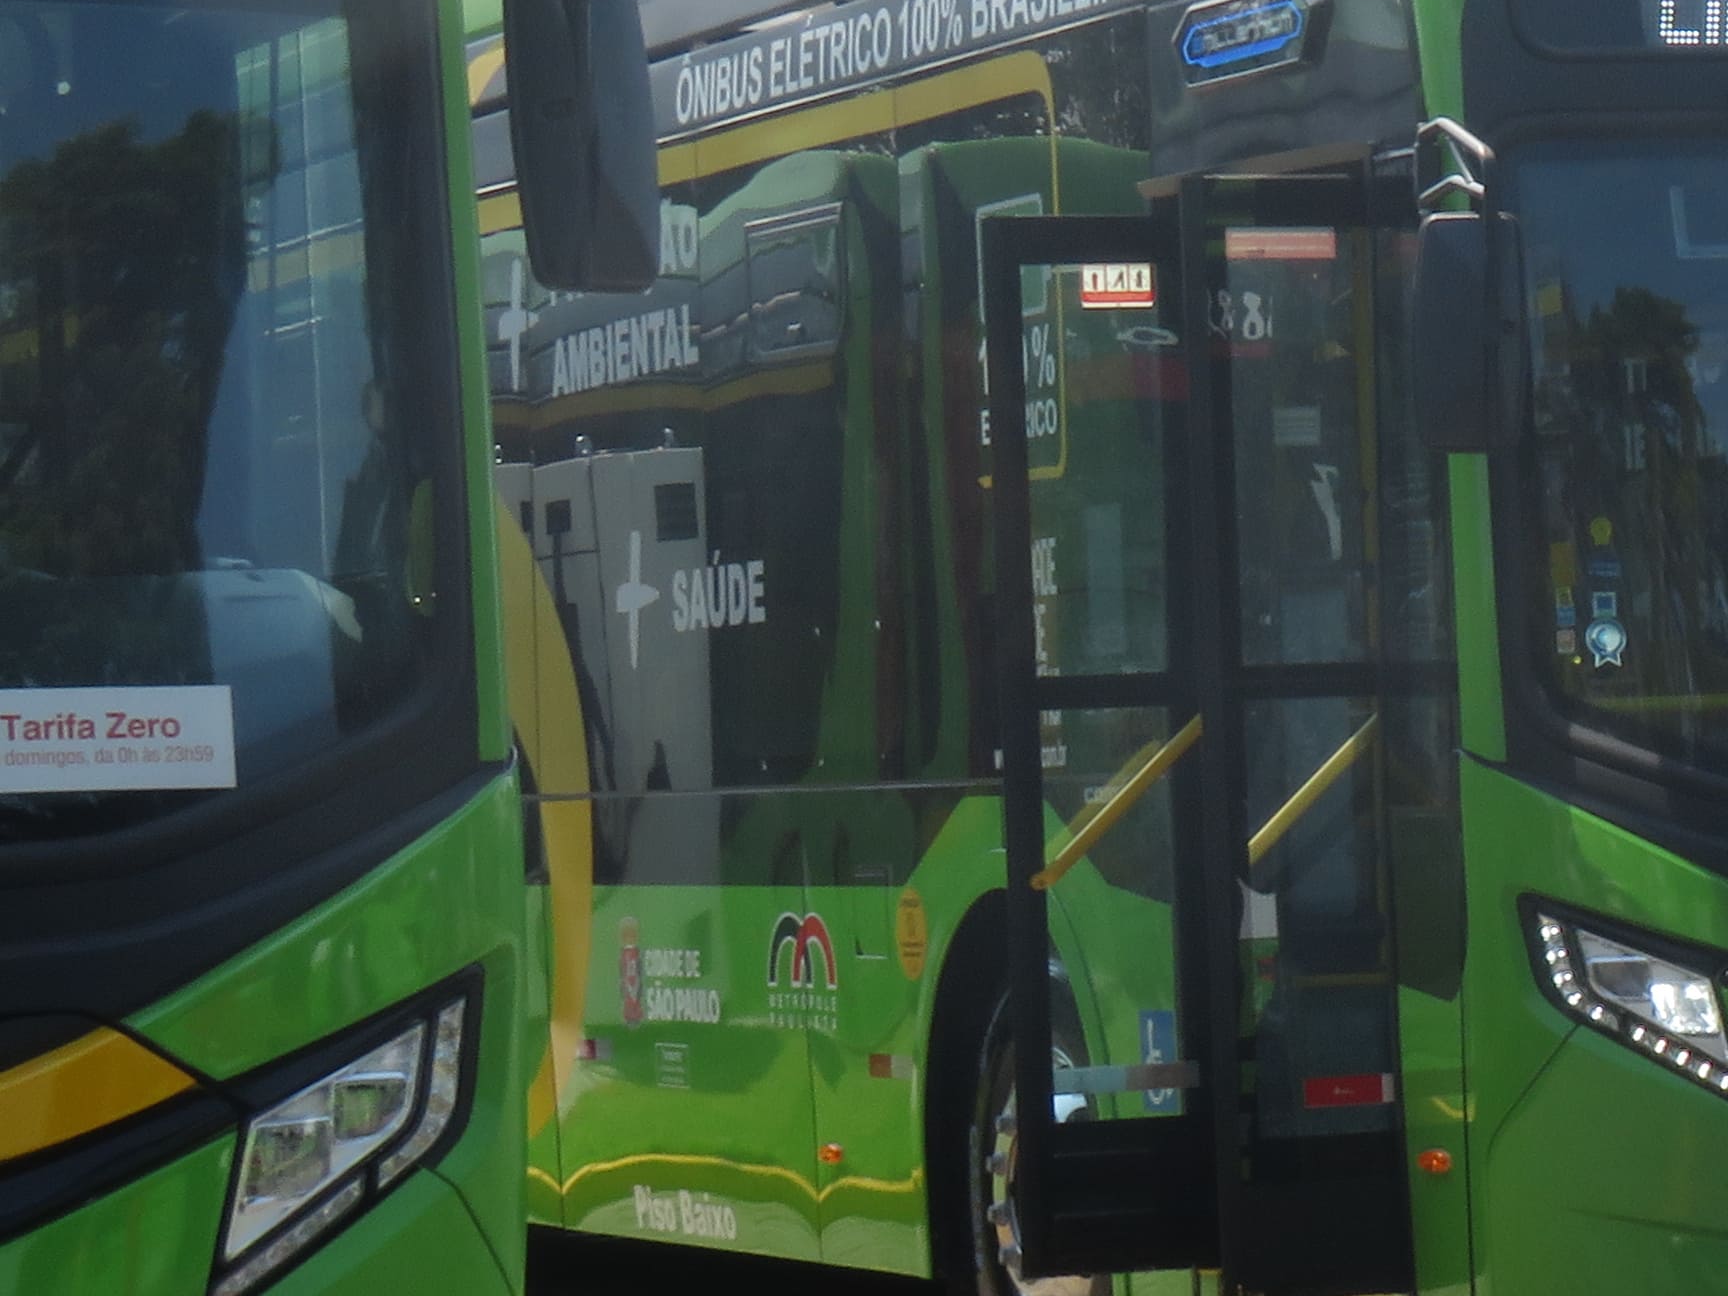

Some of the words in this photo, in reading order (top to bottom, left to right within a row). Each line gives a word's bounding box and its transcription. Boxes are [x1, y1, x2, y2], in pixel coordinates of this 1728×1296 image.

[676, 47, 763, 124] ÔNIBUS
[769, 7, 892, 99] ELÉTRICO
[552, 304, 699, 398] AMBIENTAL
[671, 550, 767, 632] SAÚDE
[0, 712, 96, 741] Tarifa
[105, 712, 181, 739] Zero
[165, 745, 214, 762] 23h59
[634, 1185, 677, 1232] Piso
[679, 1189, 737, 1241] Baixo
